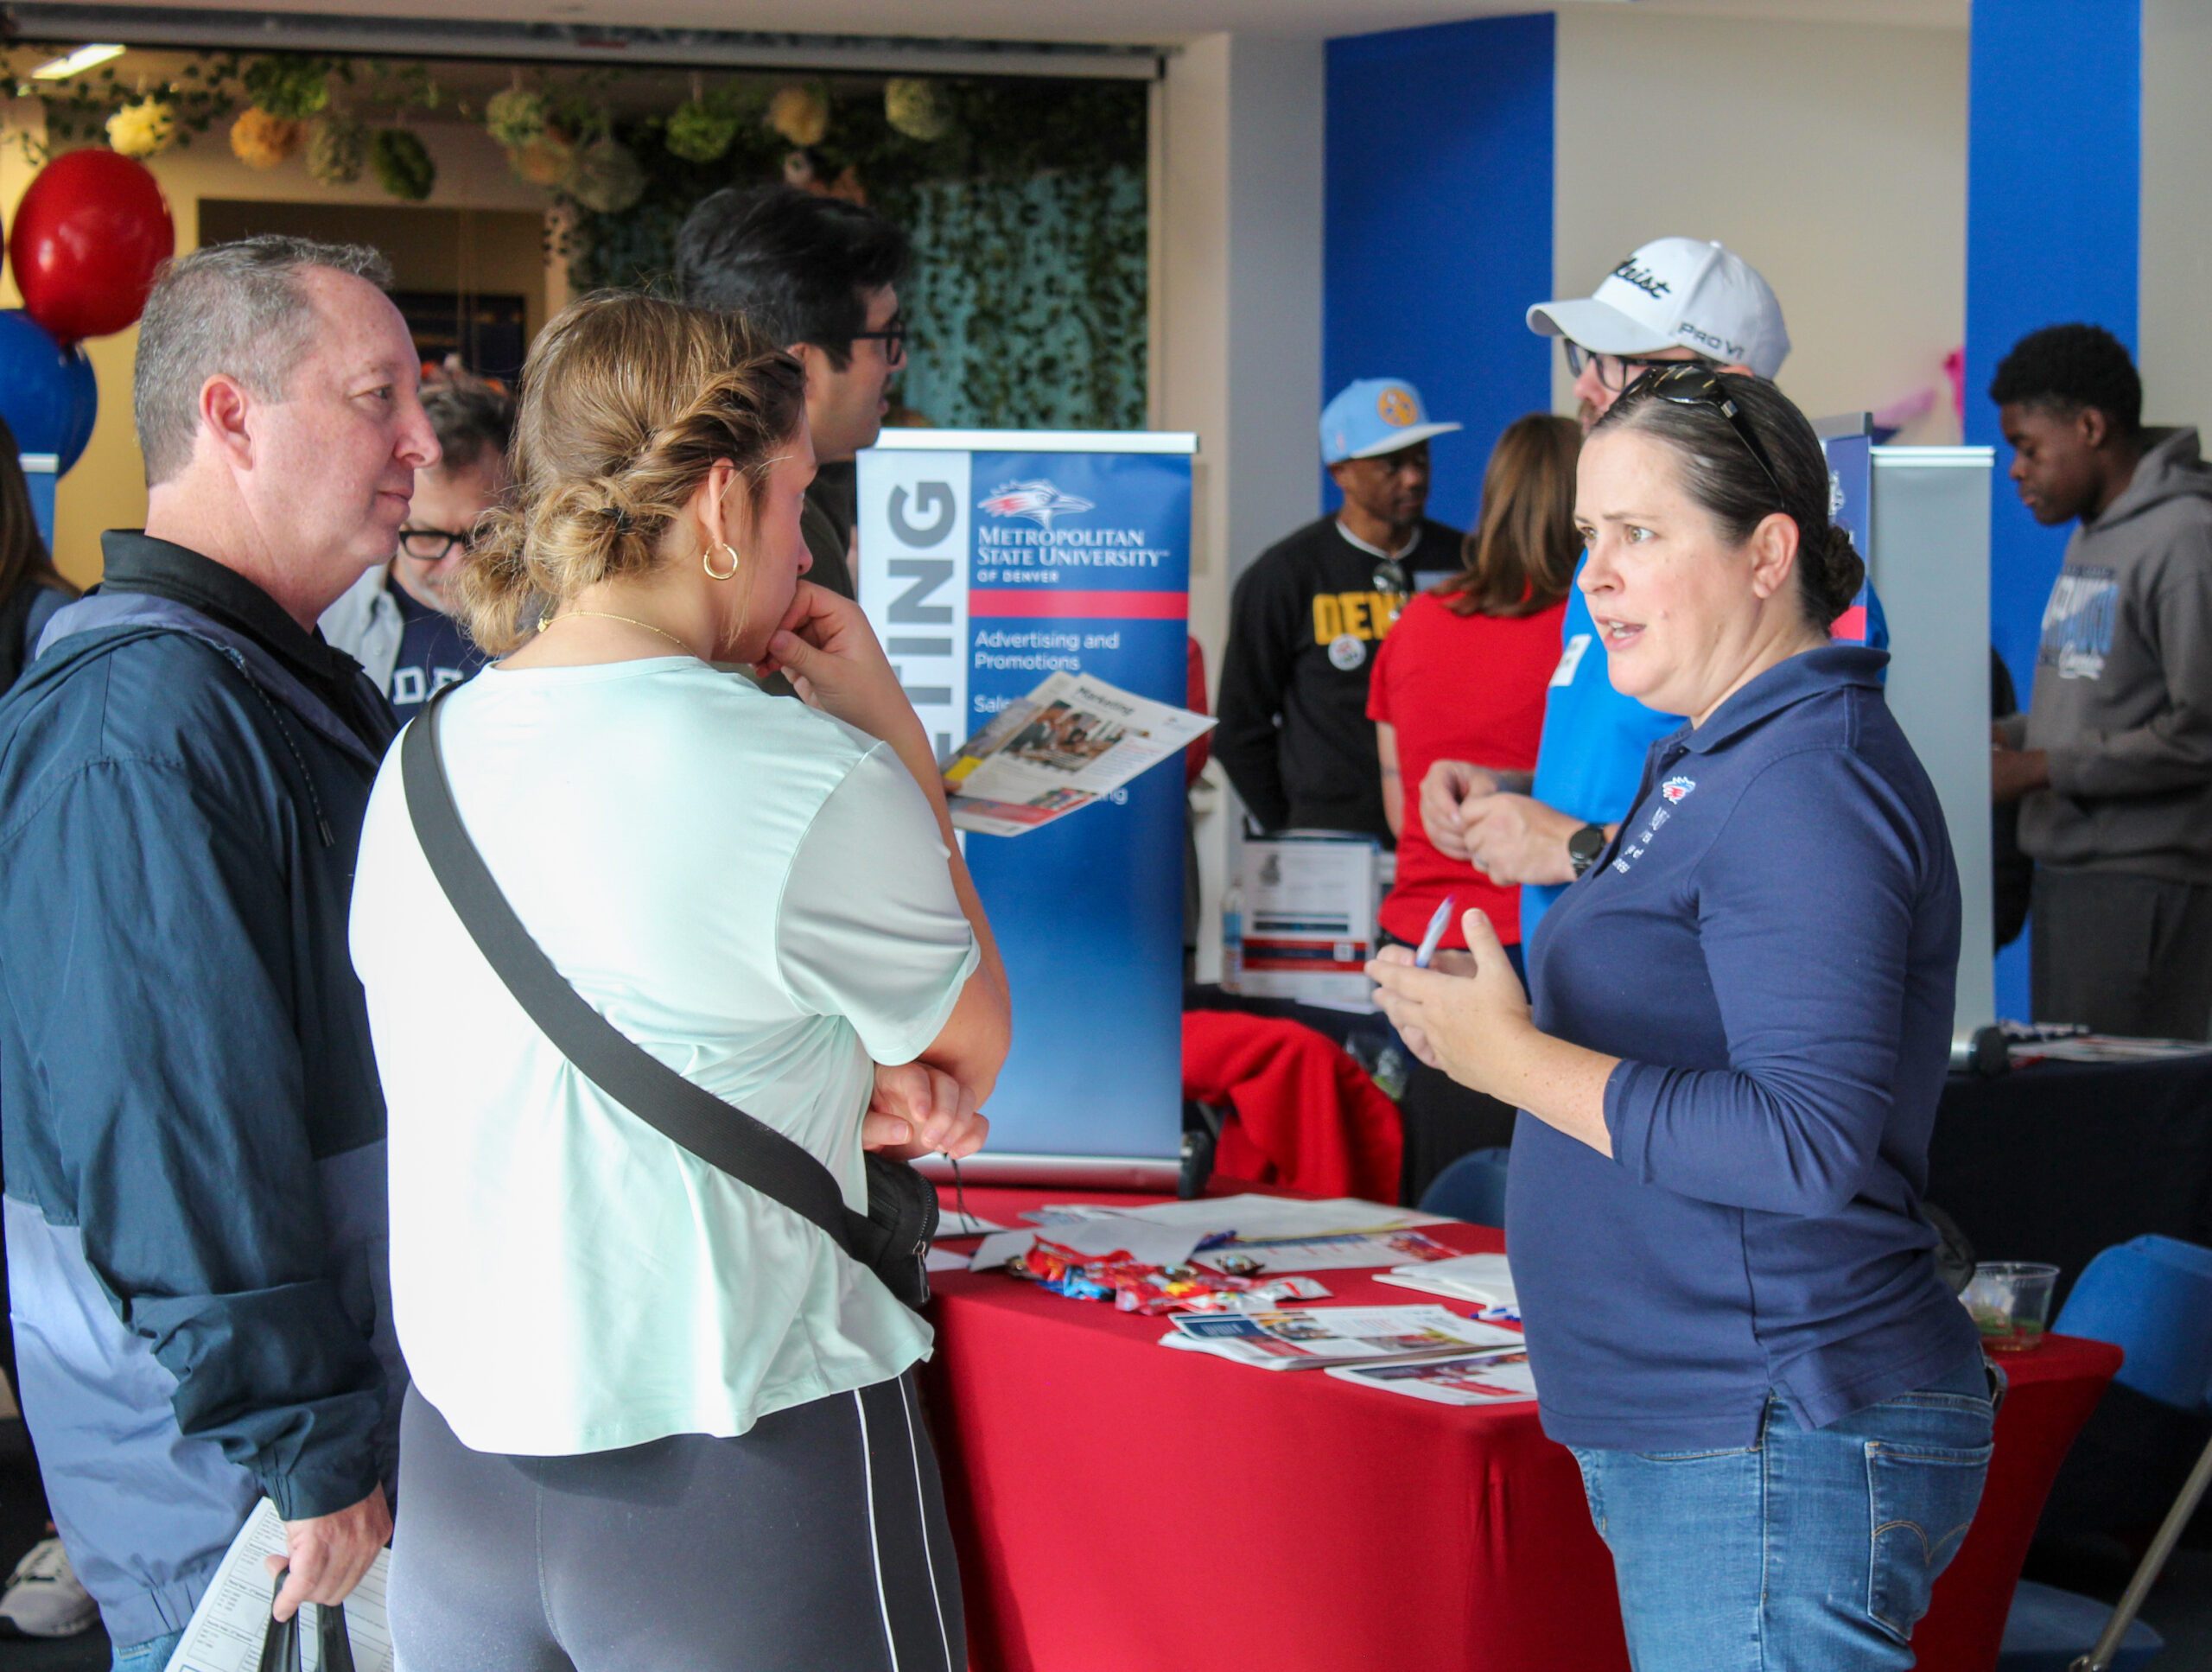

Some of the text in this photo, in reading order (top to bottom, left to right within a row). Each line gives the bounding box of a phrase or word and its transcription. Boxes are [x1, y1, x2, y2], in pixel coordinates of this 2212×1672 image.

[1678, 322, 1722, 350] PRO
[977, 526, 1146, 546] METROPOLITAN
[977, 547, 1034, 566] STATE
[977, 569, 1059, 582] OF DENVER
[887, 481, 956, 767] TING
[975, 630, 1120, 651] Advertising and
[975, 652, 1080, 671] Promotions
